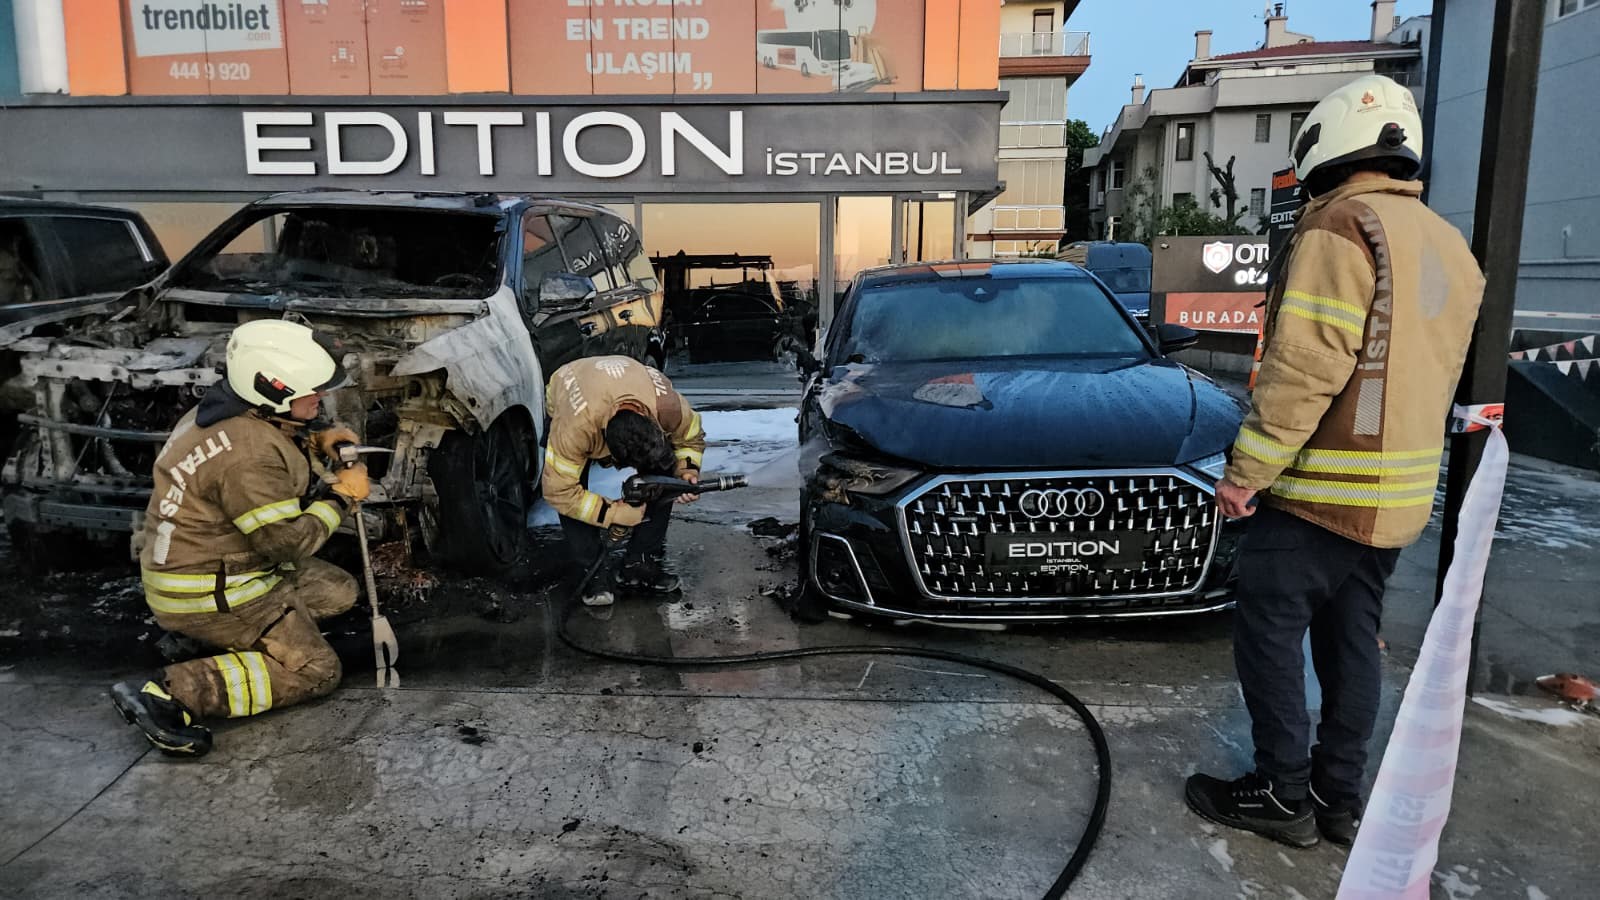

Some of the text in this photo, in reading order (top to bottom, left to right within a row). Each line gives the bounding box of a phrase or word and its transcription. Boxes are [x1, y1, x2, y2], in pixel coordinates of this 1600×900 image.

[142, 3, 270, 30] trendbilet
[566, 18, 710, 41] EN TREND
[169, 62, 250, 80] 444 9 920
[243, 110, 962, 178] EDITION İSTANBUL
[1179, 311, 1259, 324] BURADA
[1008, 540, 1120, 558] EDITION
[1040, 563, 1089, 572] EDITION
